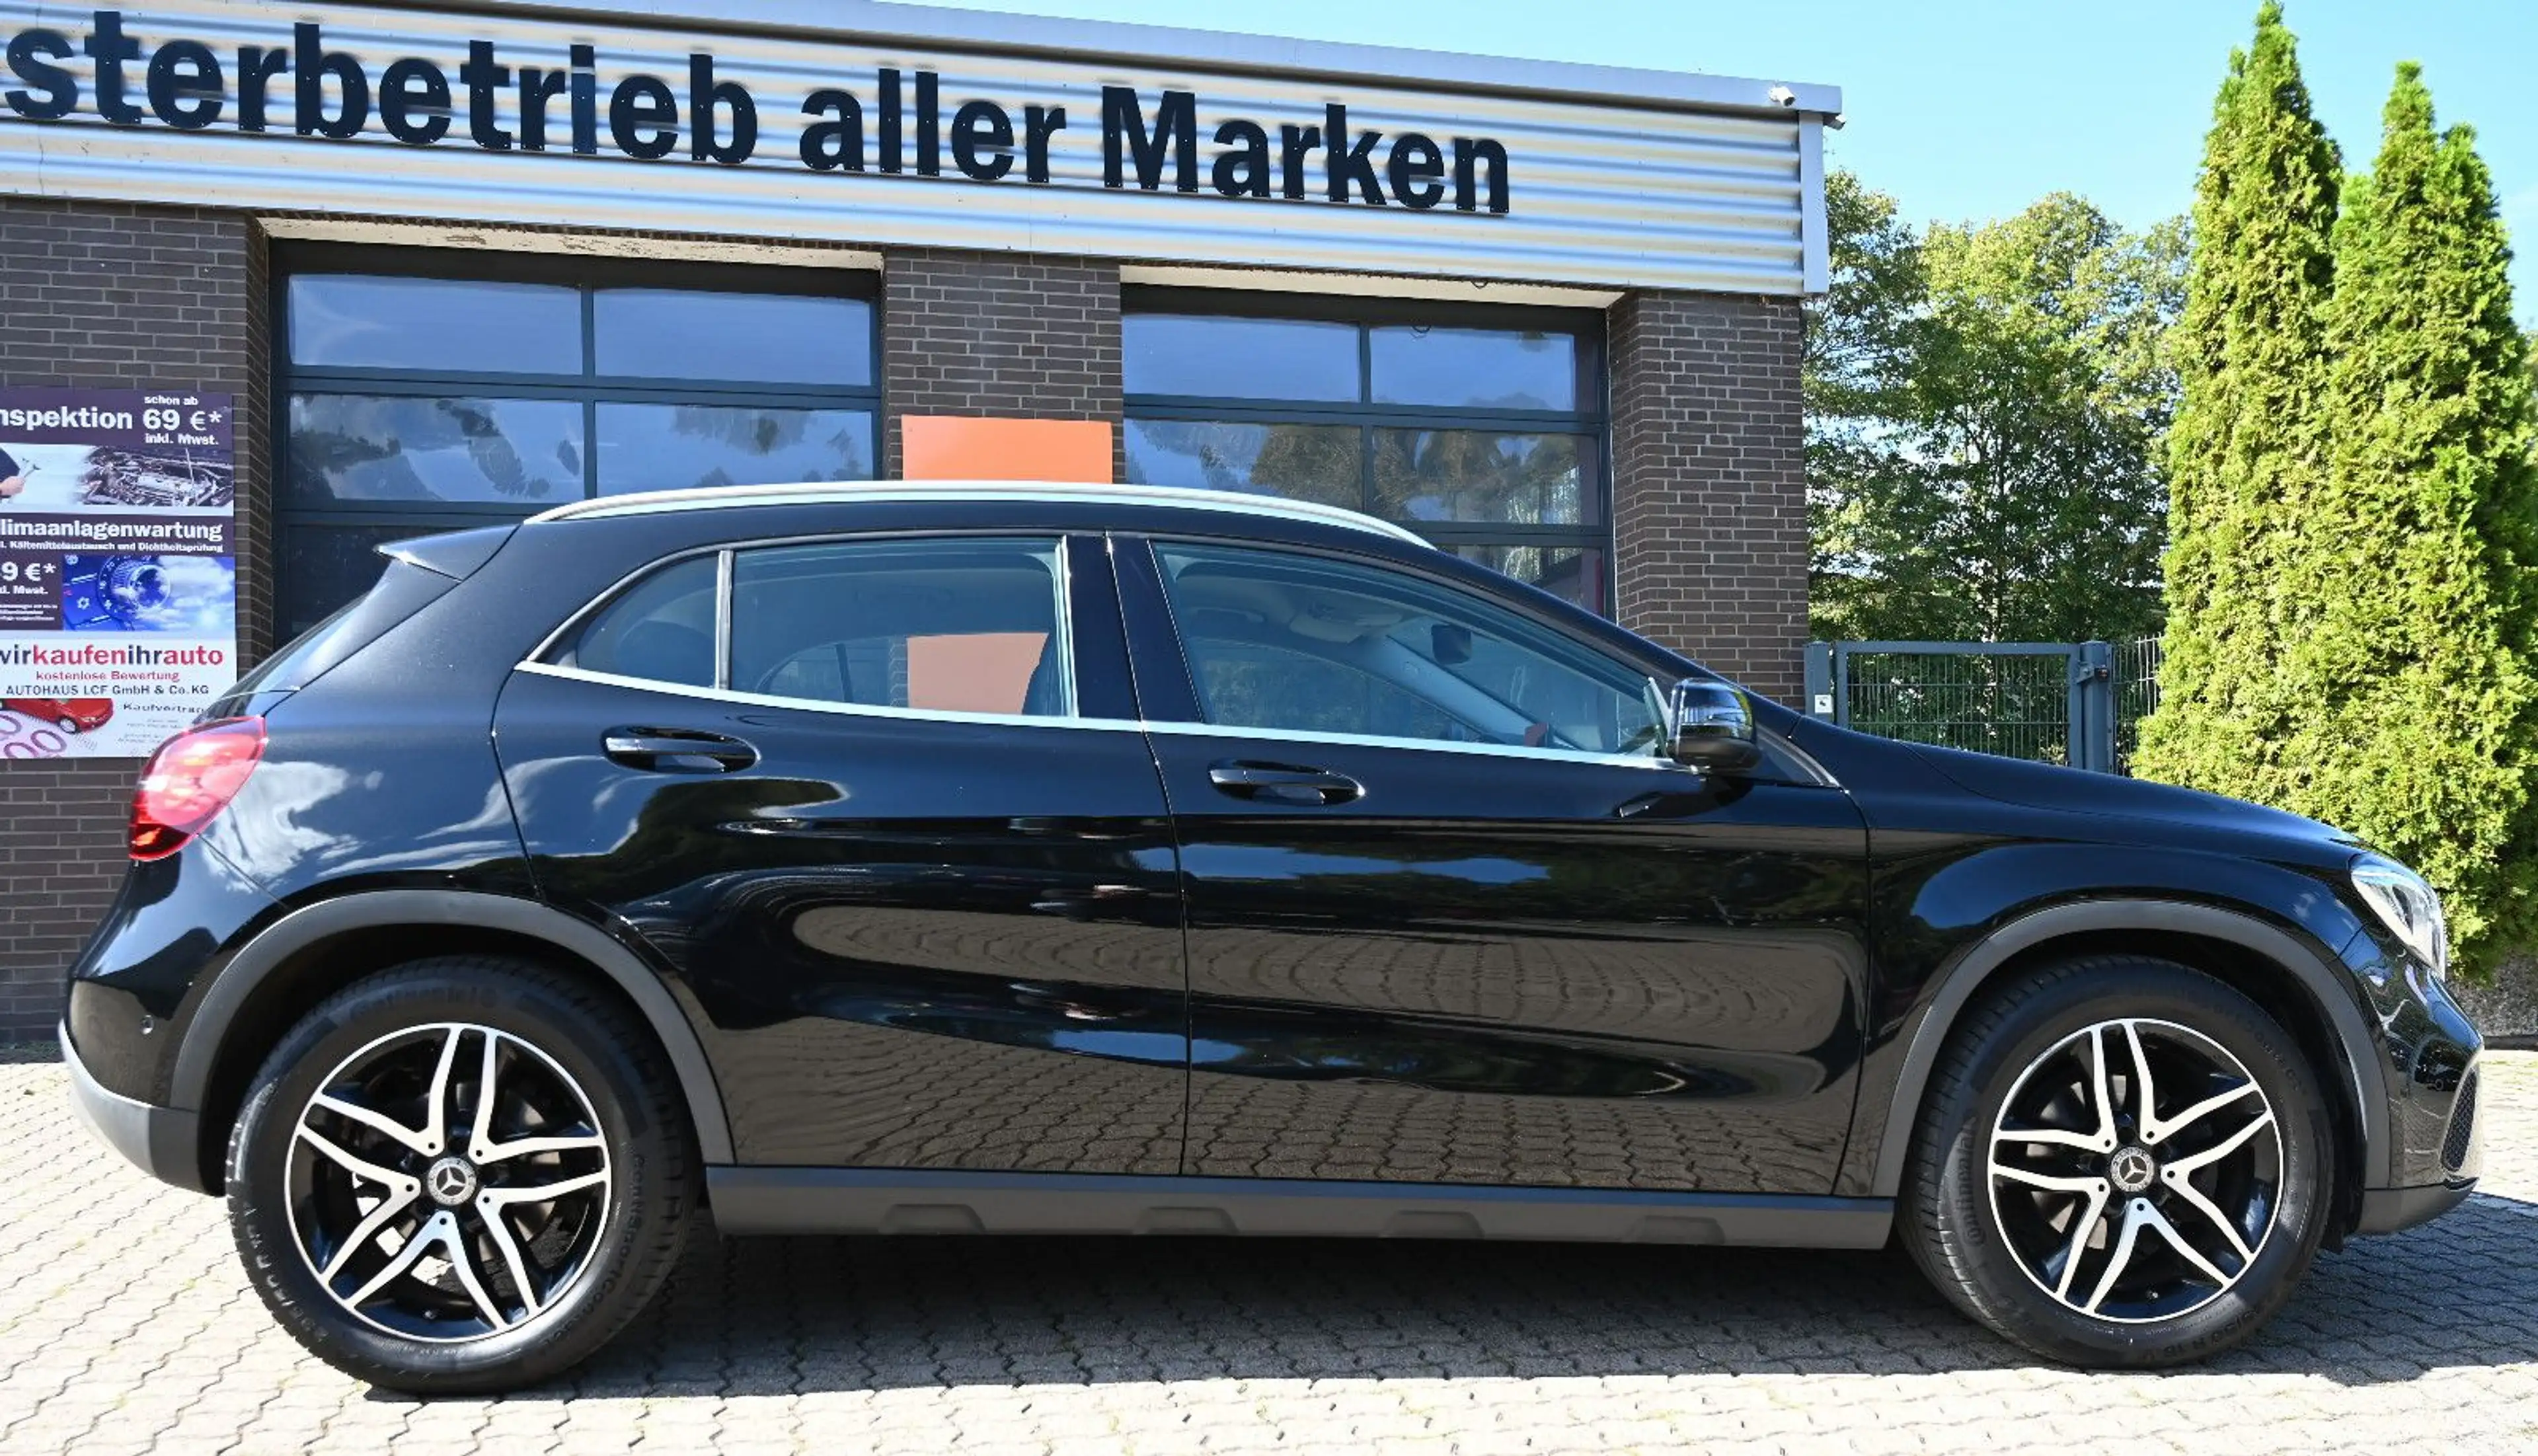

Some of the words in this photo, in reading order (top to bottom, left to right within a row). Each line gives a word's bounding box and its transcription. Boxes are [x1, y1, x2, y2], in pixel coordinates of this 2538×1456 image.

[5, 11, 757, 165] sterbetrieb
[799, 68, 1066, 182] aller
[1102, 85, 1510, 214] Marken
[144, 395, 180, 405] schon
[182, 396, 198, 406] ab
[143, 408, 180, 430] 69
[145, 433, 174, 443] inkl.
[36, 671, 106, 680] kostenlose
[111, 670, 180, 683] Bewertung
[6, 685, 79, 695] AUTOHAUS
[84, 685, 108, 695] LCF
[112, 685, 149, 695] GmbH
[154, 685, 164, 695] &
